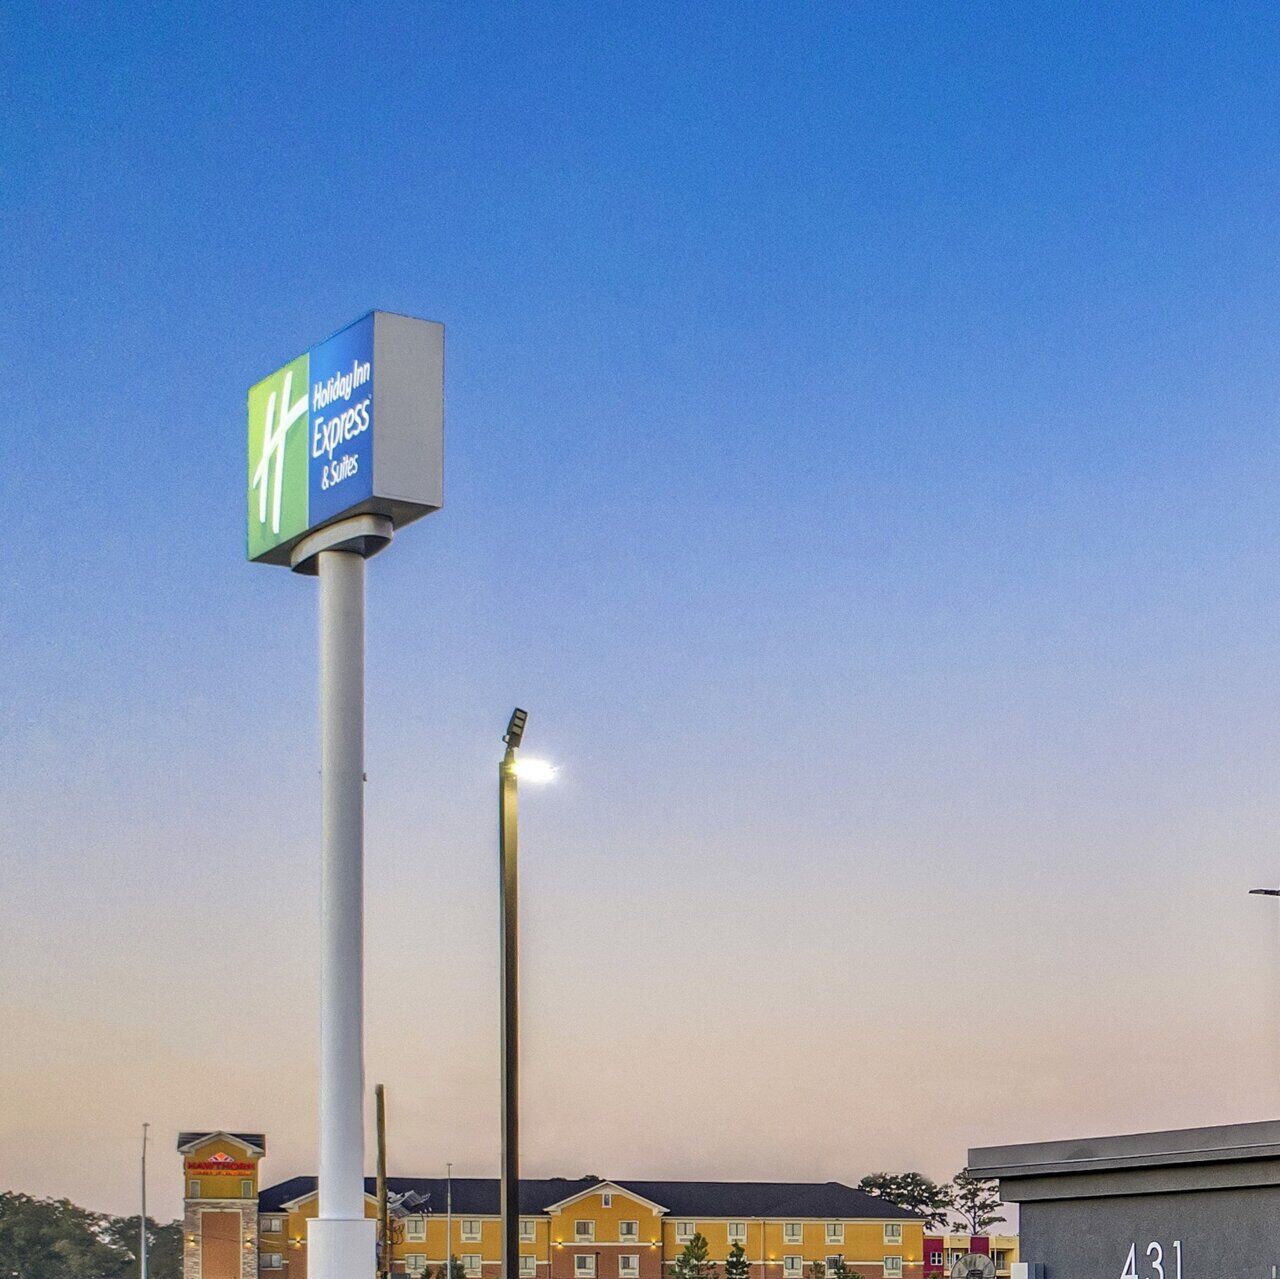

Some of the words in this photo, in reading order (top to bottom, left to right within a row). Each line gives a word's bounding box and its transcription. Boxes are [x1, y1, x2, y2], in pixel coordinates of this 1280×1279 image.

[313, 371, 352, 412] Holiday
[353, 360, 370, 388] Inn
[312, 398, 370, 460] Express
[321, 464, 329, 490] &
[330, 454, 358, 483] Suites
